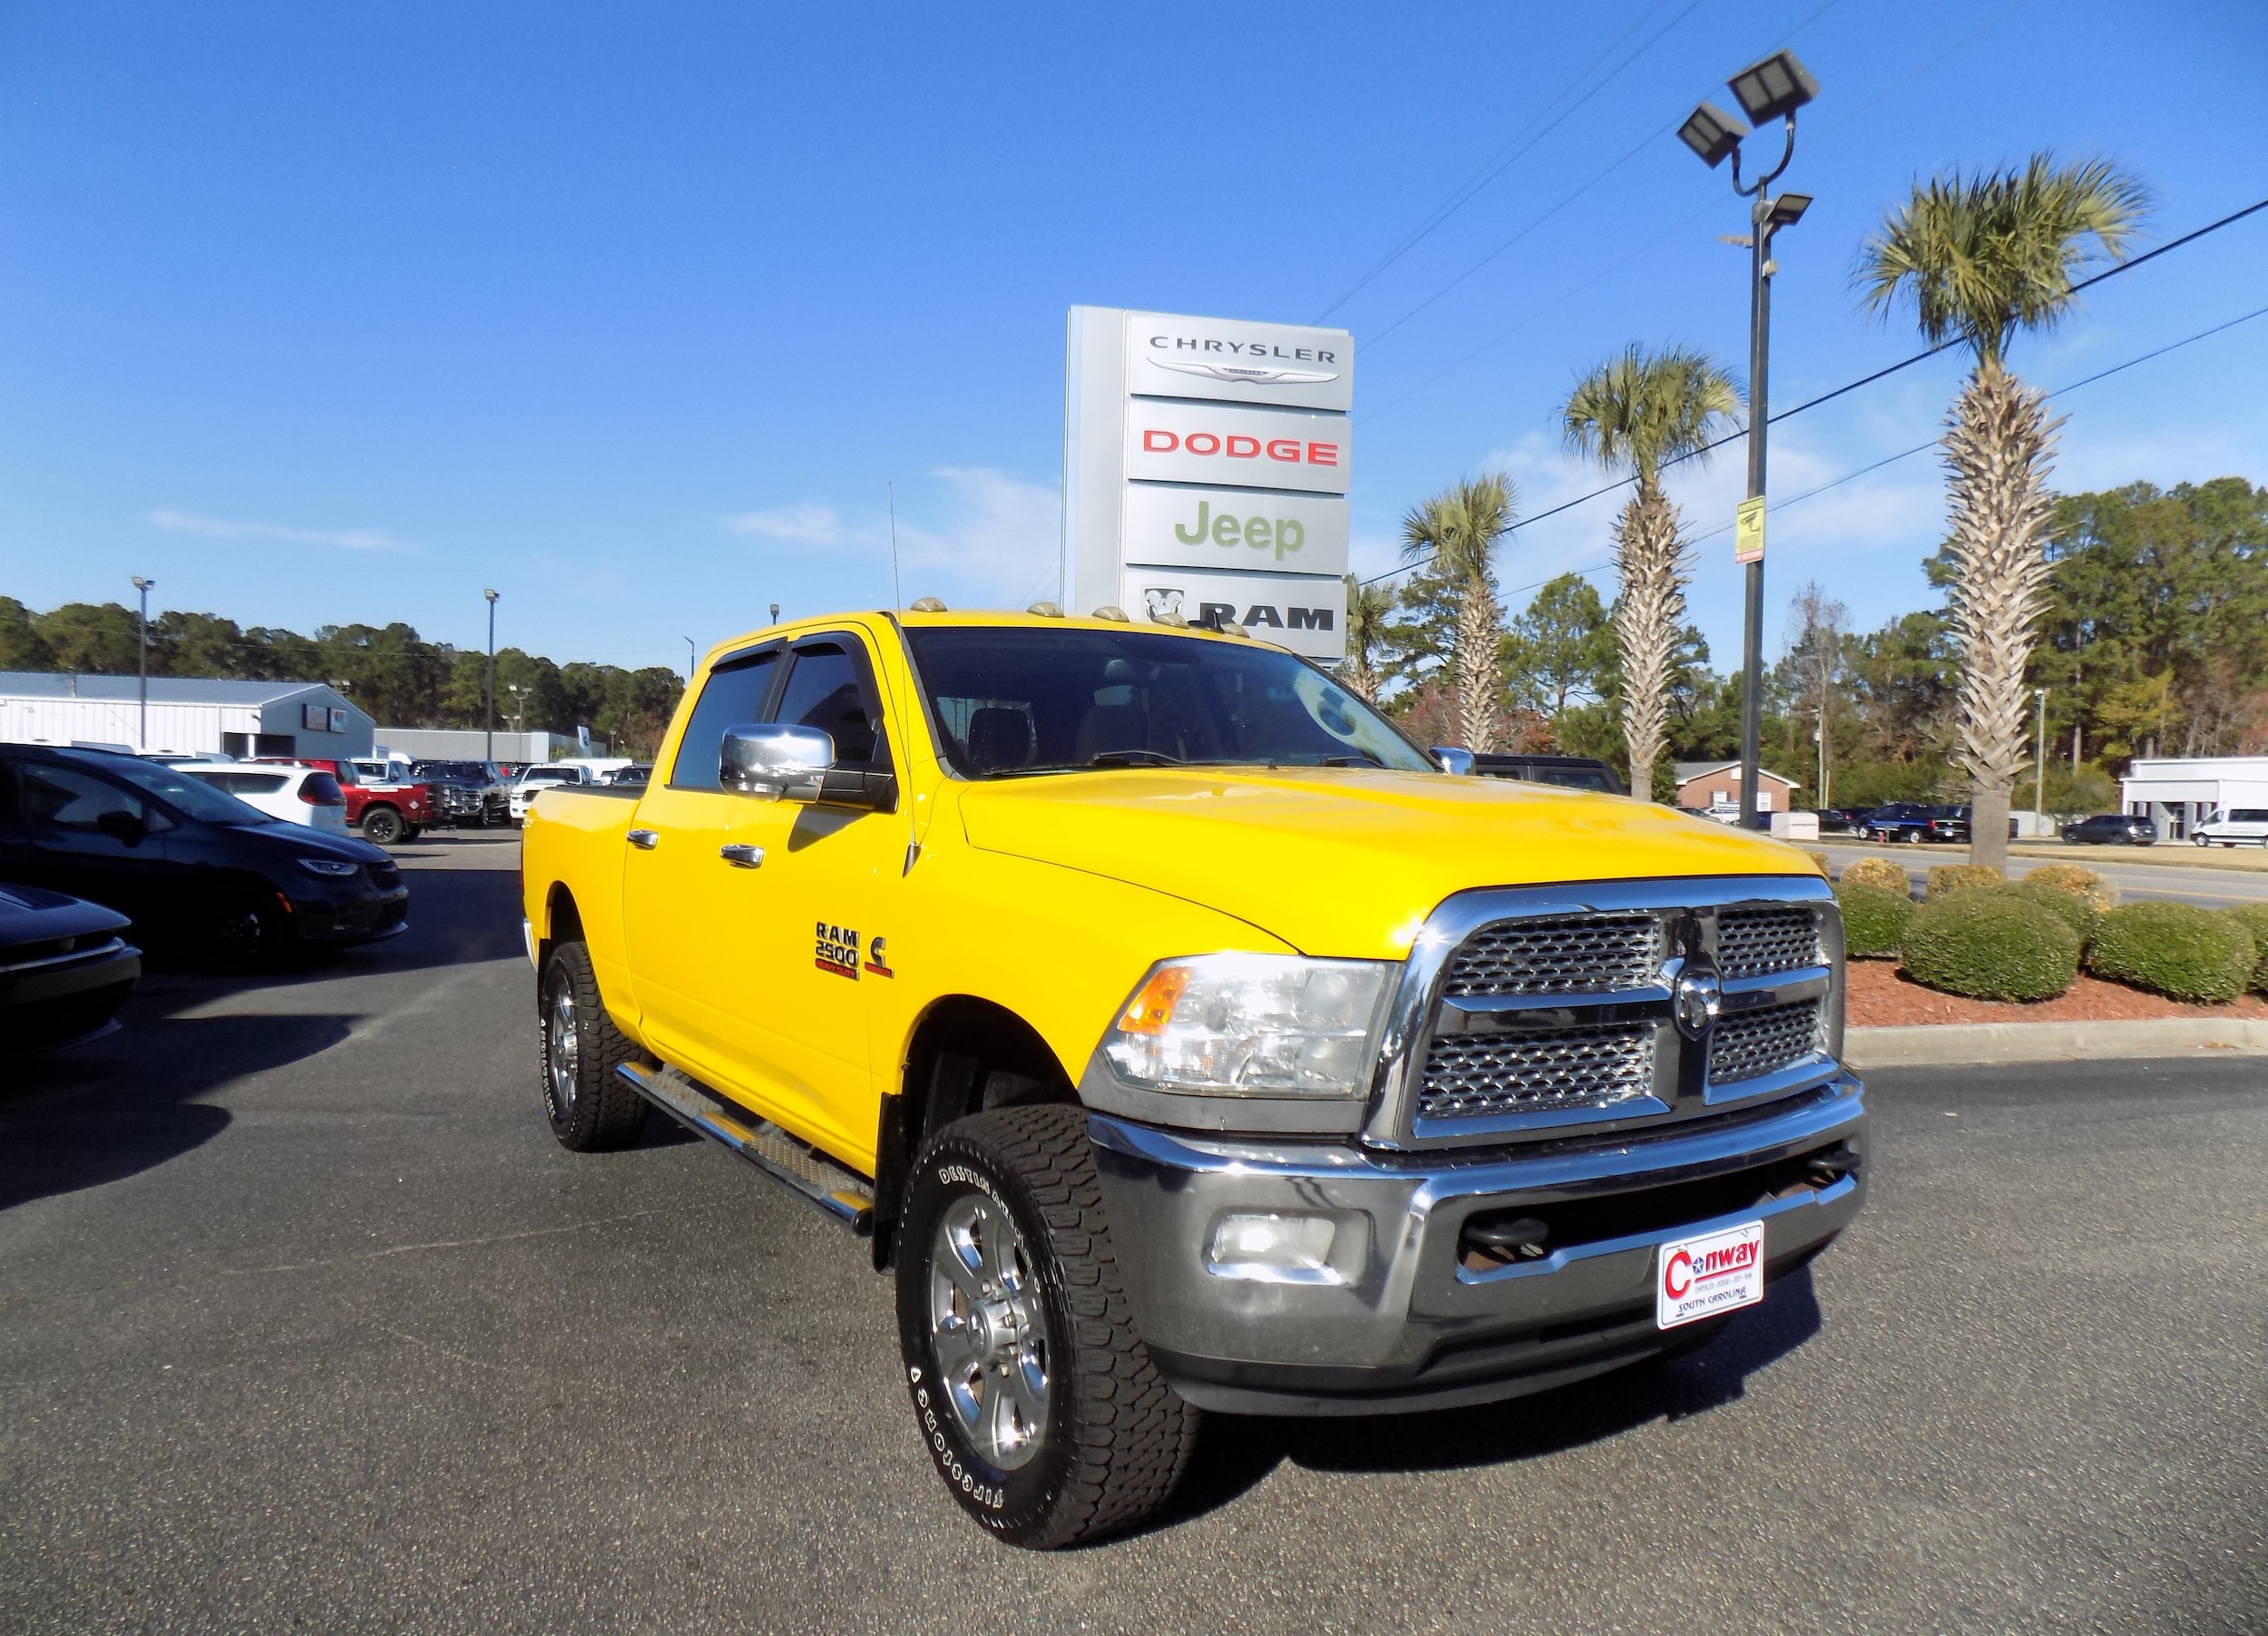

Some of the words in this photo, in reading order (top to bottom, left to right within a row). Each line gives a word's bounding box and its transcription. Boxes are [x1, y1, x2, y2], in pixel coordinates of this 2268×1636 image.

[1149, 336, 1336, 363] CHRYSLER
[1143, 429, 1339, 467] DODGE
[1175, 500, 1305, 561] Jeep
[1199, 602, 1334, 632] RAM
[816, 921, 860, 949] RAM
[816, 939, 860, 968] 2500
[1678, 1298, 1706, 1313] SOUTH
[1707, 1286, 1746, 1304] CAROLINA
